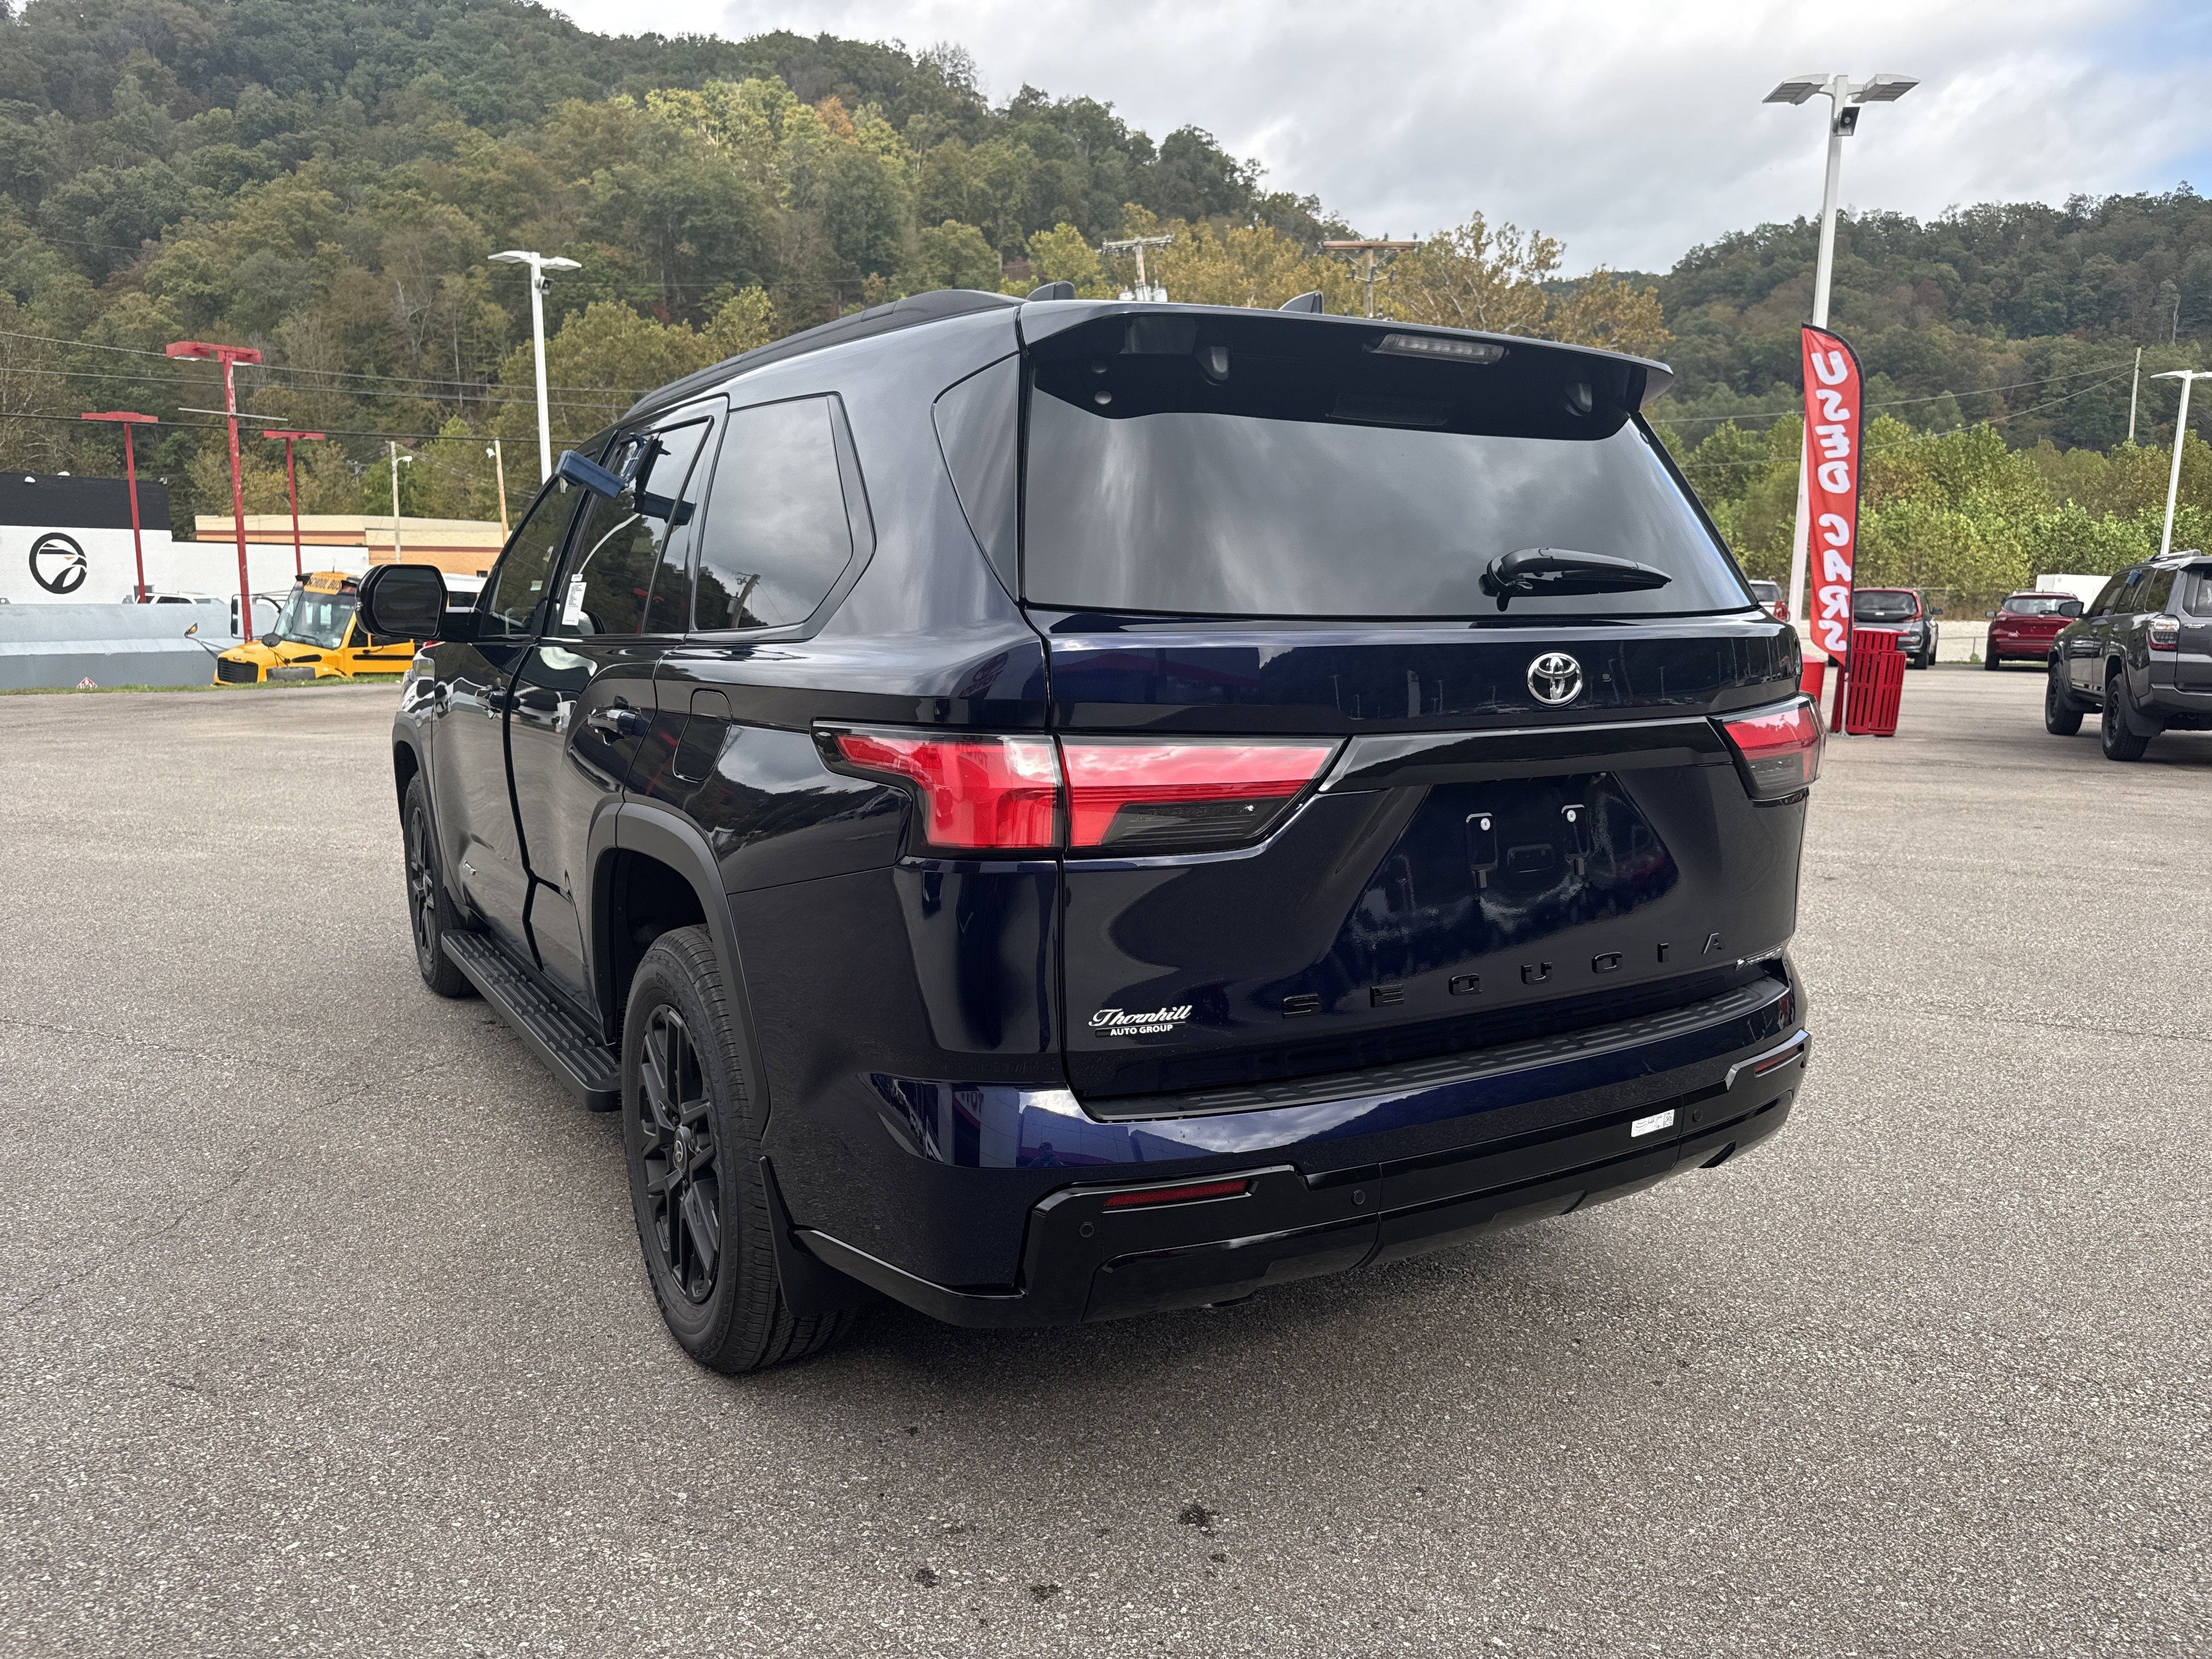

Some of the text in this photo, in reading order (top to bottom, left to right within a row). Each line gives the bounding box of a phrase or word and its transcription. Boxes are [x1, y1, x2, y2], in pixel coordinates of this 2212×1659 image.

[1282, 932, 1726, 1019] SEQUOIA
[1088, 1005, 1193, 1027] Thornhill
[1110, 1024, 1173, 1036] AUTO GROUP
